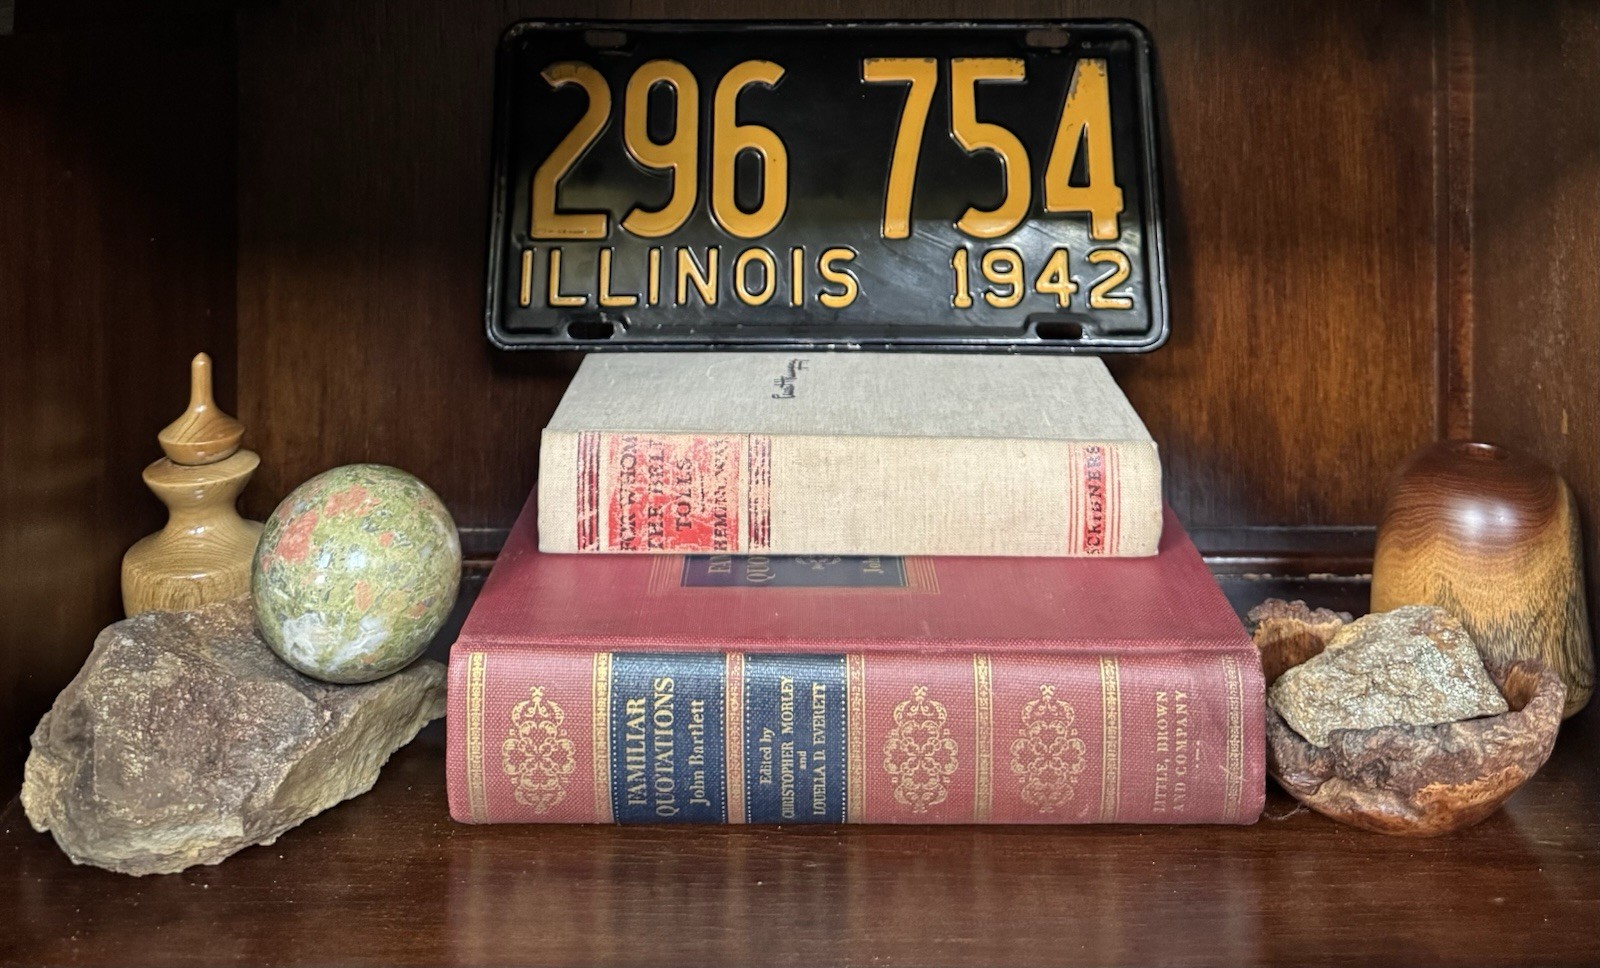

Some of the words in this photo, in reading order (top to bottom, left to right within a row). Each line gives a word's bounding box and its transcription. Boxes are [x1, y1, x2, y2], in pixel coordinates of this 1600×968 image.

[530, 59, 788, 240] 296
[860, 57, 1125, 241] 754
[520, 246, 859, 310] ILLINOIS
[951, 247, 1134, 310] 1942
[676, 456, 692, 532] TOLLS
[713, 439, 728, 551] HEMINWAY
[647, 505, 664, 551] THE
[688, 700, 704, 765] Bartlett
[759, 727, 776, 742] by
[780, 676, 794, 734] MORLEY
[812, 682, 826, 746] EVERETT
[1156, 691, 1169, 752] BROWN
[1174, 690, 1188, 776] COMPANY
[626, 697, 648, 806] FAMILIAR
[654, 677, 680, 817] QUOTATIONS
[759, 744, 772, 786] Edited
[799, 750, 807, 770] and
[813, 749, 825, 761] D.
[689, 770, 711, 806] John
[781, 741, 795, 820] CHRISTOPHER
[813, 765, 826, 815] LOUELLA
[1153, 758, 1170, 813] LITTLE,
[1173, 783, 1187, 812] AND
